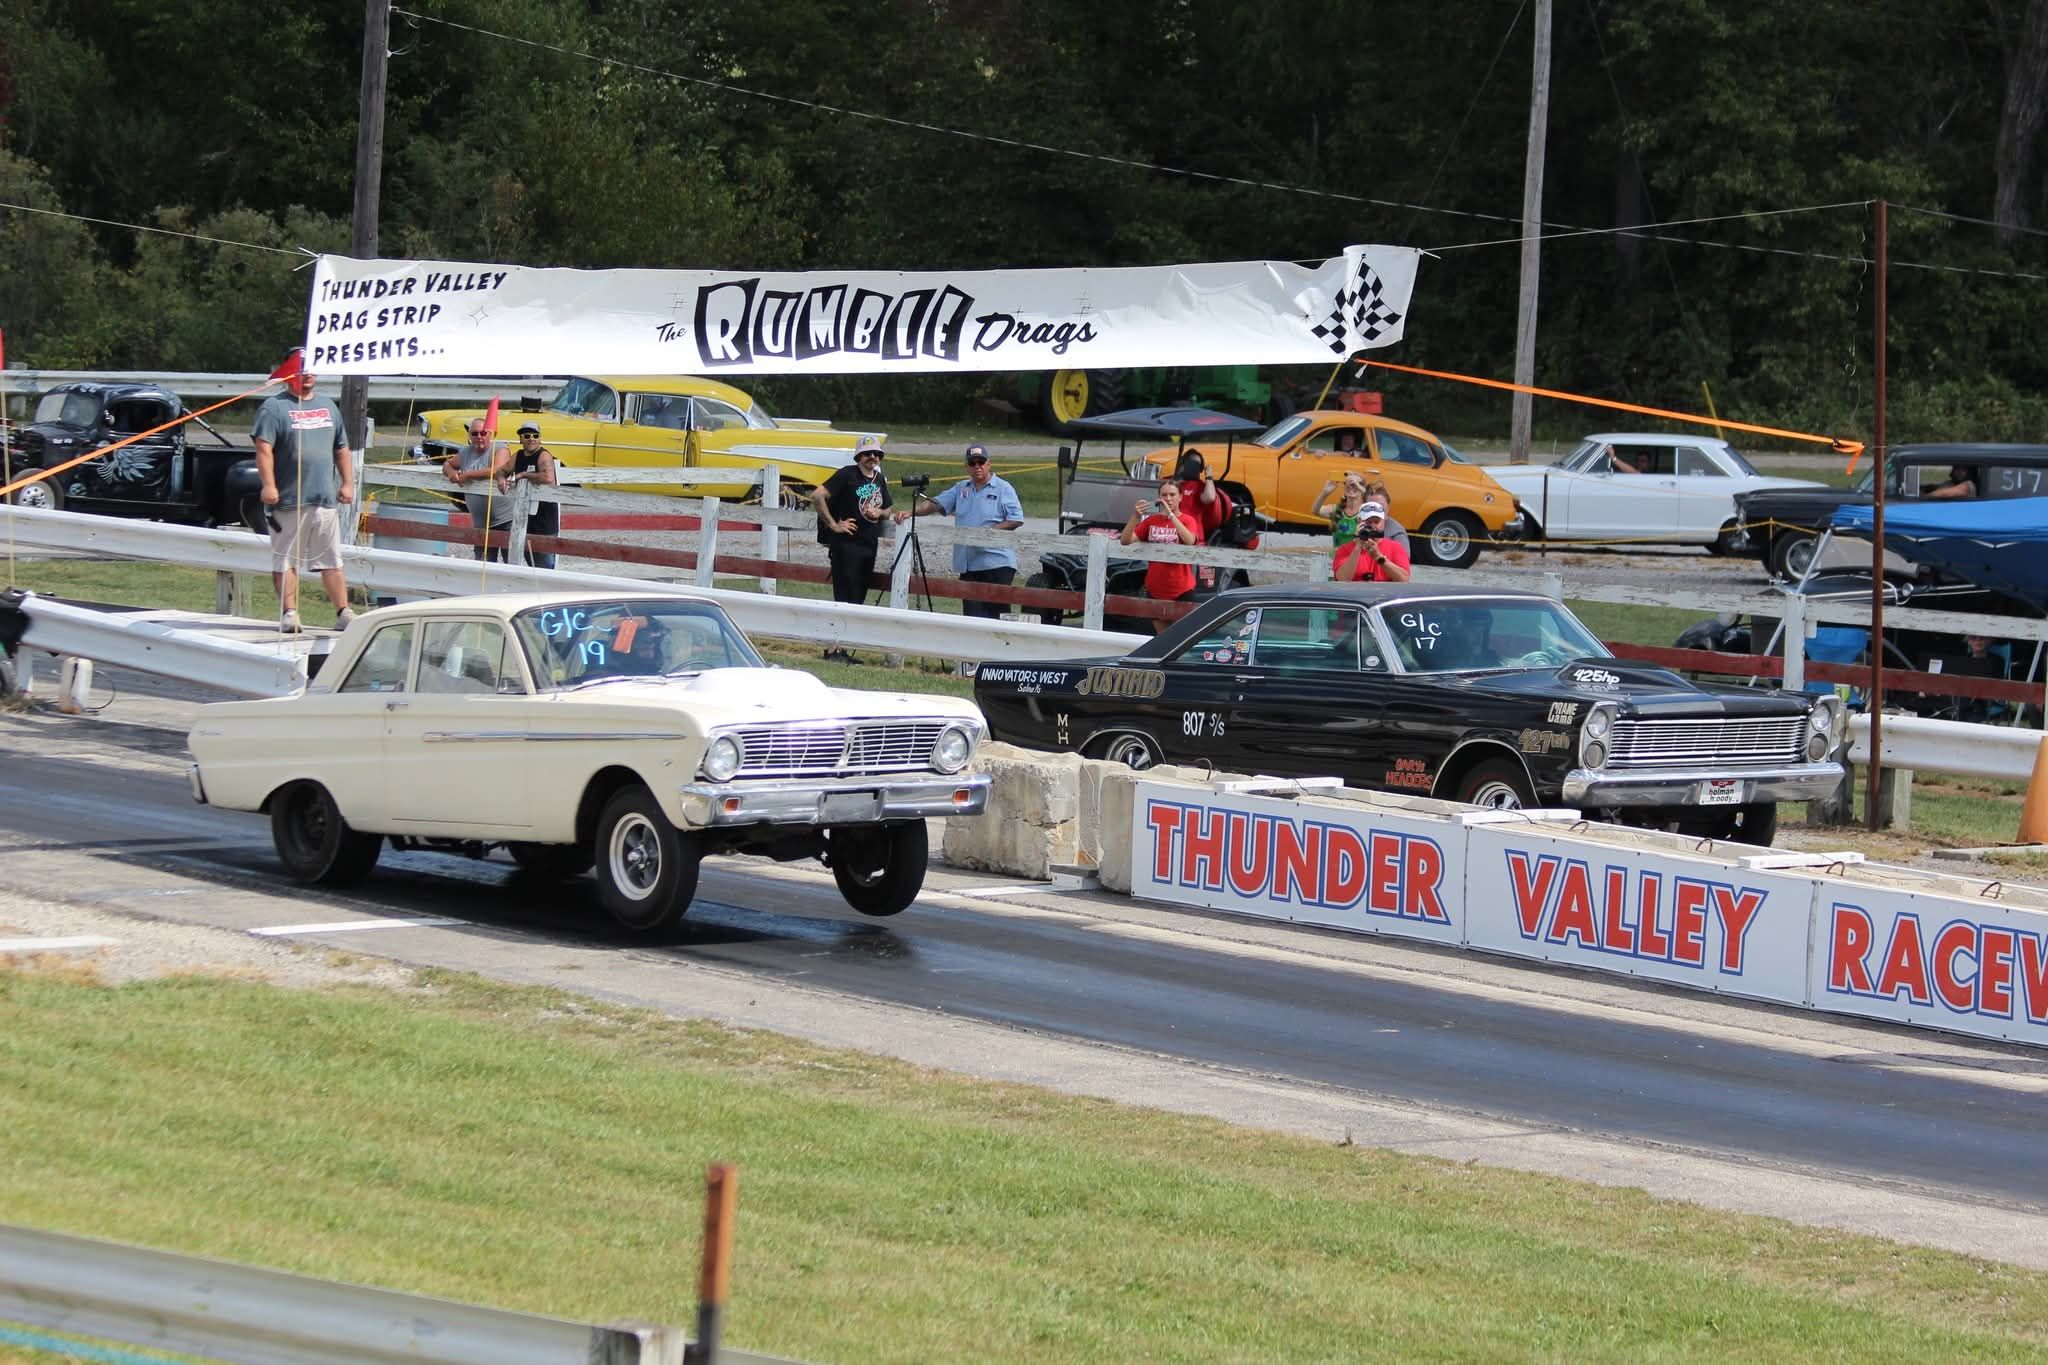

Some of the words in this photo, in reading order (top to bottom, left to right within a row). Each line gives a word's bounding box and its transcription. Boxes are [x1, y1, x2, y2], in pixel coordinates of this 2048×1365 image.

[322, 277, 418, 302] THUNDER
[424, 272, 507, 293] VALLEY
[317, 310, 369, 334] DRAG
[377, 304, 441, 327] STRIP
[656, 323, 688, 343] The
[694, 278, 975, 367] RUMBLE
[973, 312, 1098, 354] Drags
[313, 337, 444, 366] PRESENTS...
[2001, 469, 2042, 494] 517
[579, 641, 605, 664] 19
[1415, 637, 1436, 650] 17
[981, 668, 1037, 684] INNOVATORS
[1038, 672, 1068, 685] WEST
[1573, 668, 1620, 684] 425hp
[1057, 713, 1069, 727] M
[1183, 711, 1205, 736] 807
[1057, 732, 1069, 745] H
[1147, 800, 1452, 926] THUNDER
[1504, 848, 1769, 976] VALLEY
